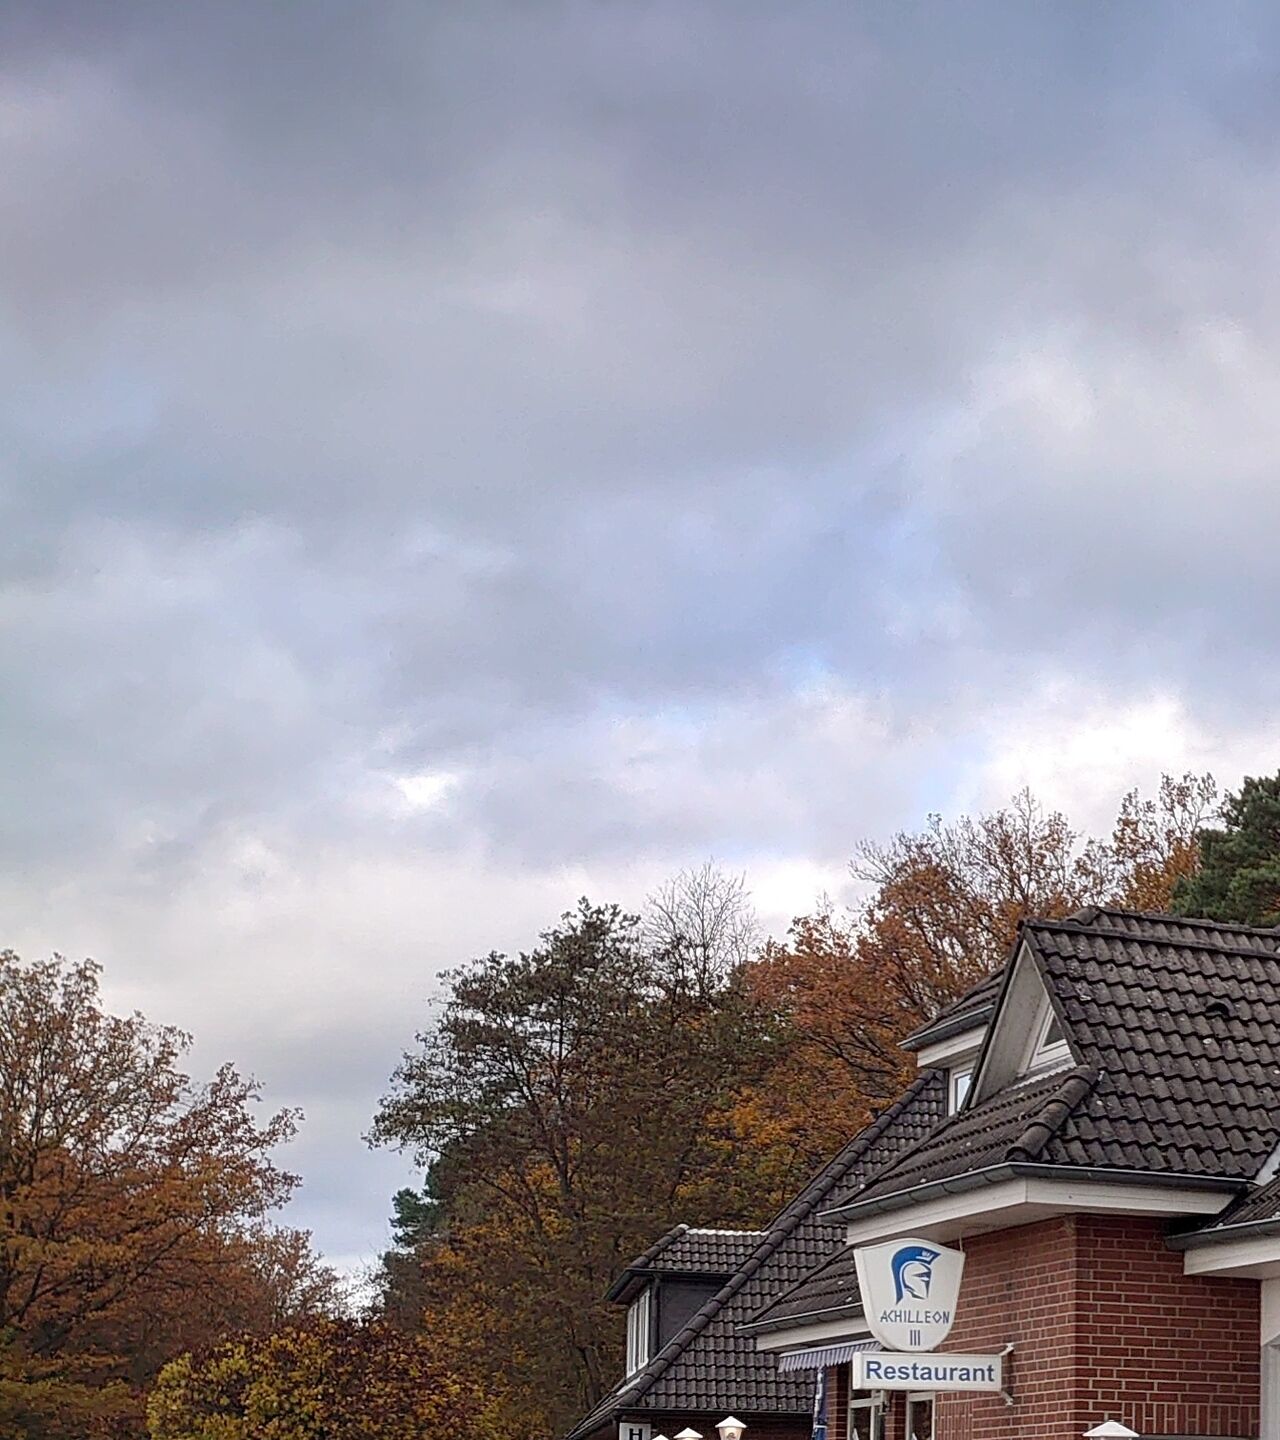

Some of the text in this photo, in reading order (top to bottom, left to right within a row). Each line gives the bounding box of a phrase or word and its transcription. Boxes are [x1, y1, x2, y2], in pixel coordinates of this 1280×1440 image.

[880, 1310, 950, 1324] ACHILLEON
[909, 1329, 921, 1346] III
[865, 1360, 995, 1382] Restaurant
